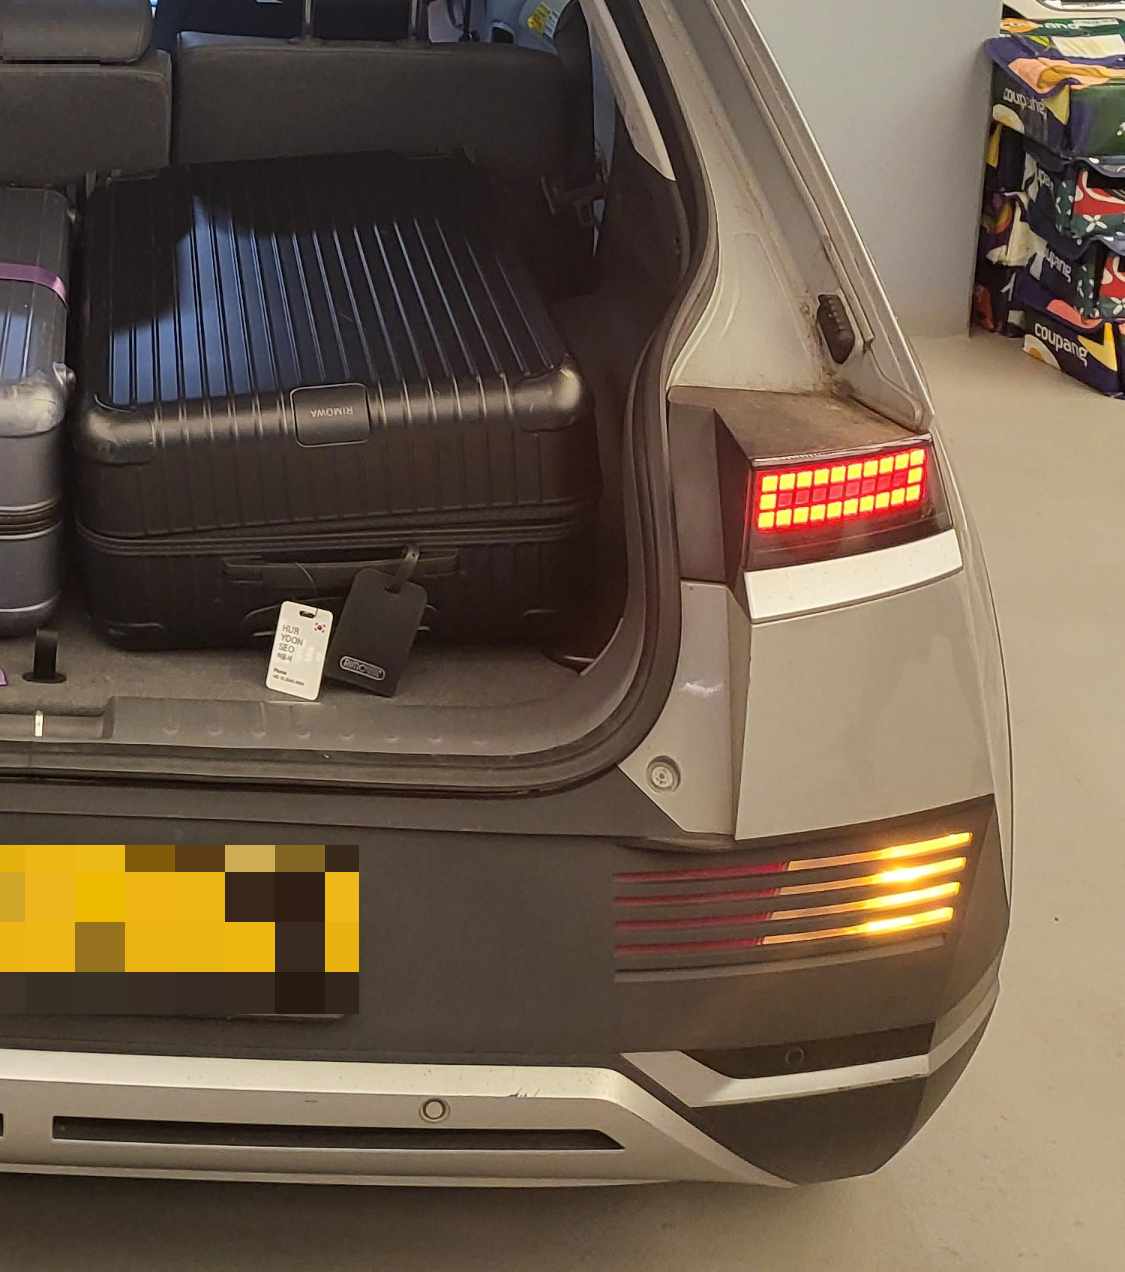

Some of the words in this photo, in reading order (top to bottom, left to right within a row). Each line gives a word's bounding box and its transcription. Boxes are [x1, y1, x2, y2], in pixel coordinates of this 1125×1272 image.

[1035, 322, 1088, 368] coupang
[309, 406, 354, 418] RIMOWA
[282, 624, 300, 636] HUR
[281, 633, 304, 646] YOON
[278, 642, 295, 654] SEO
